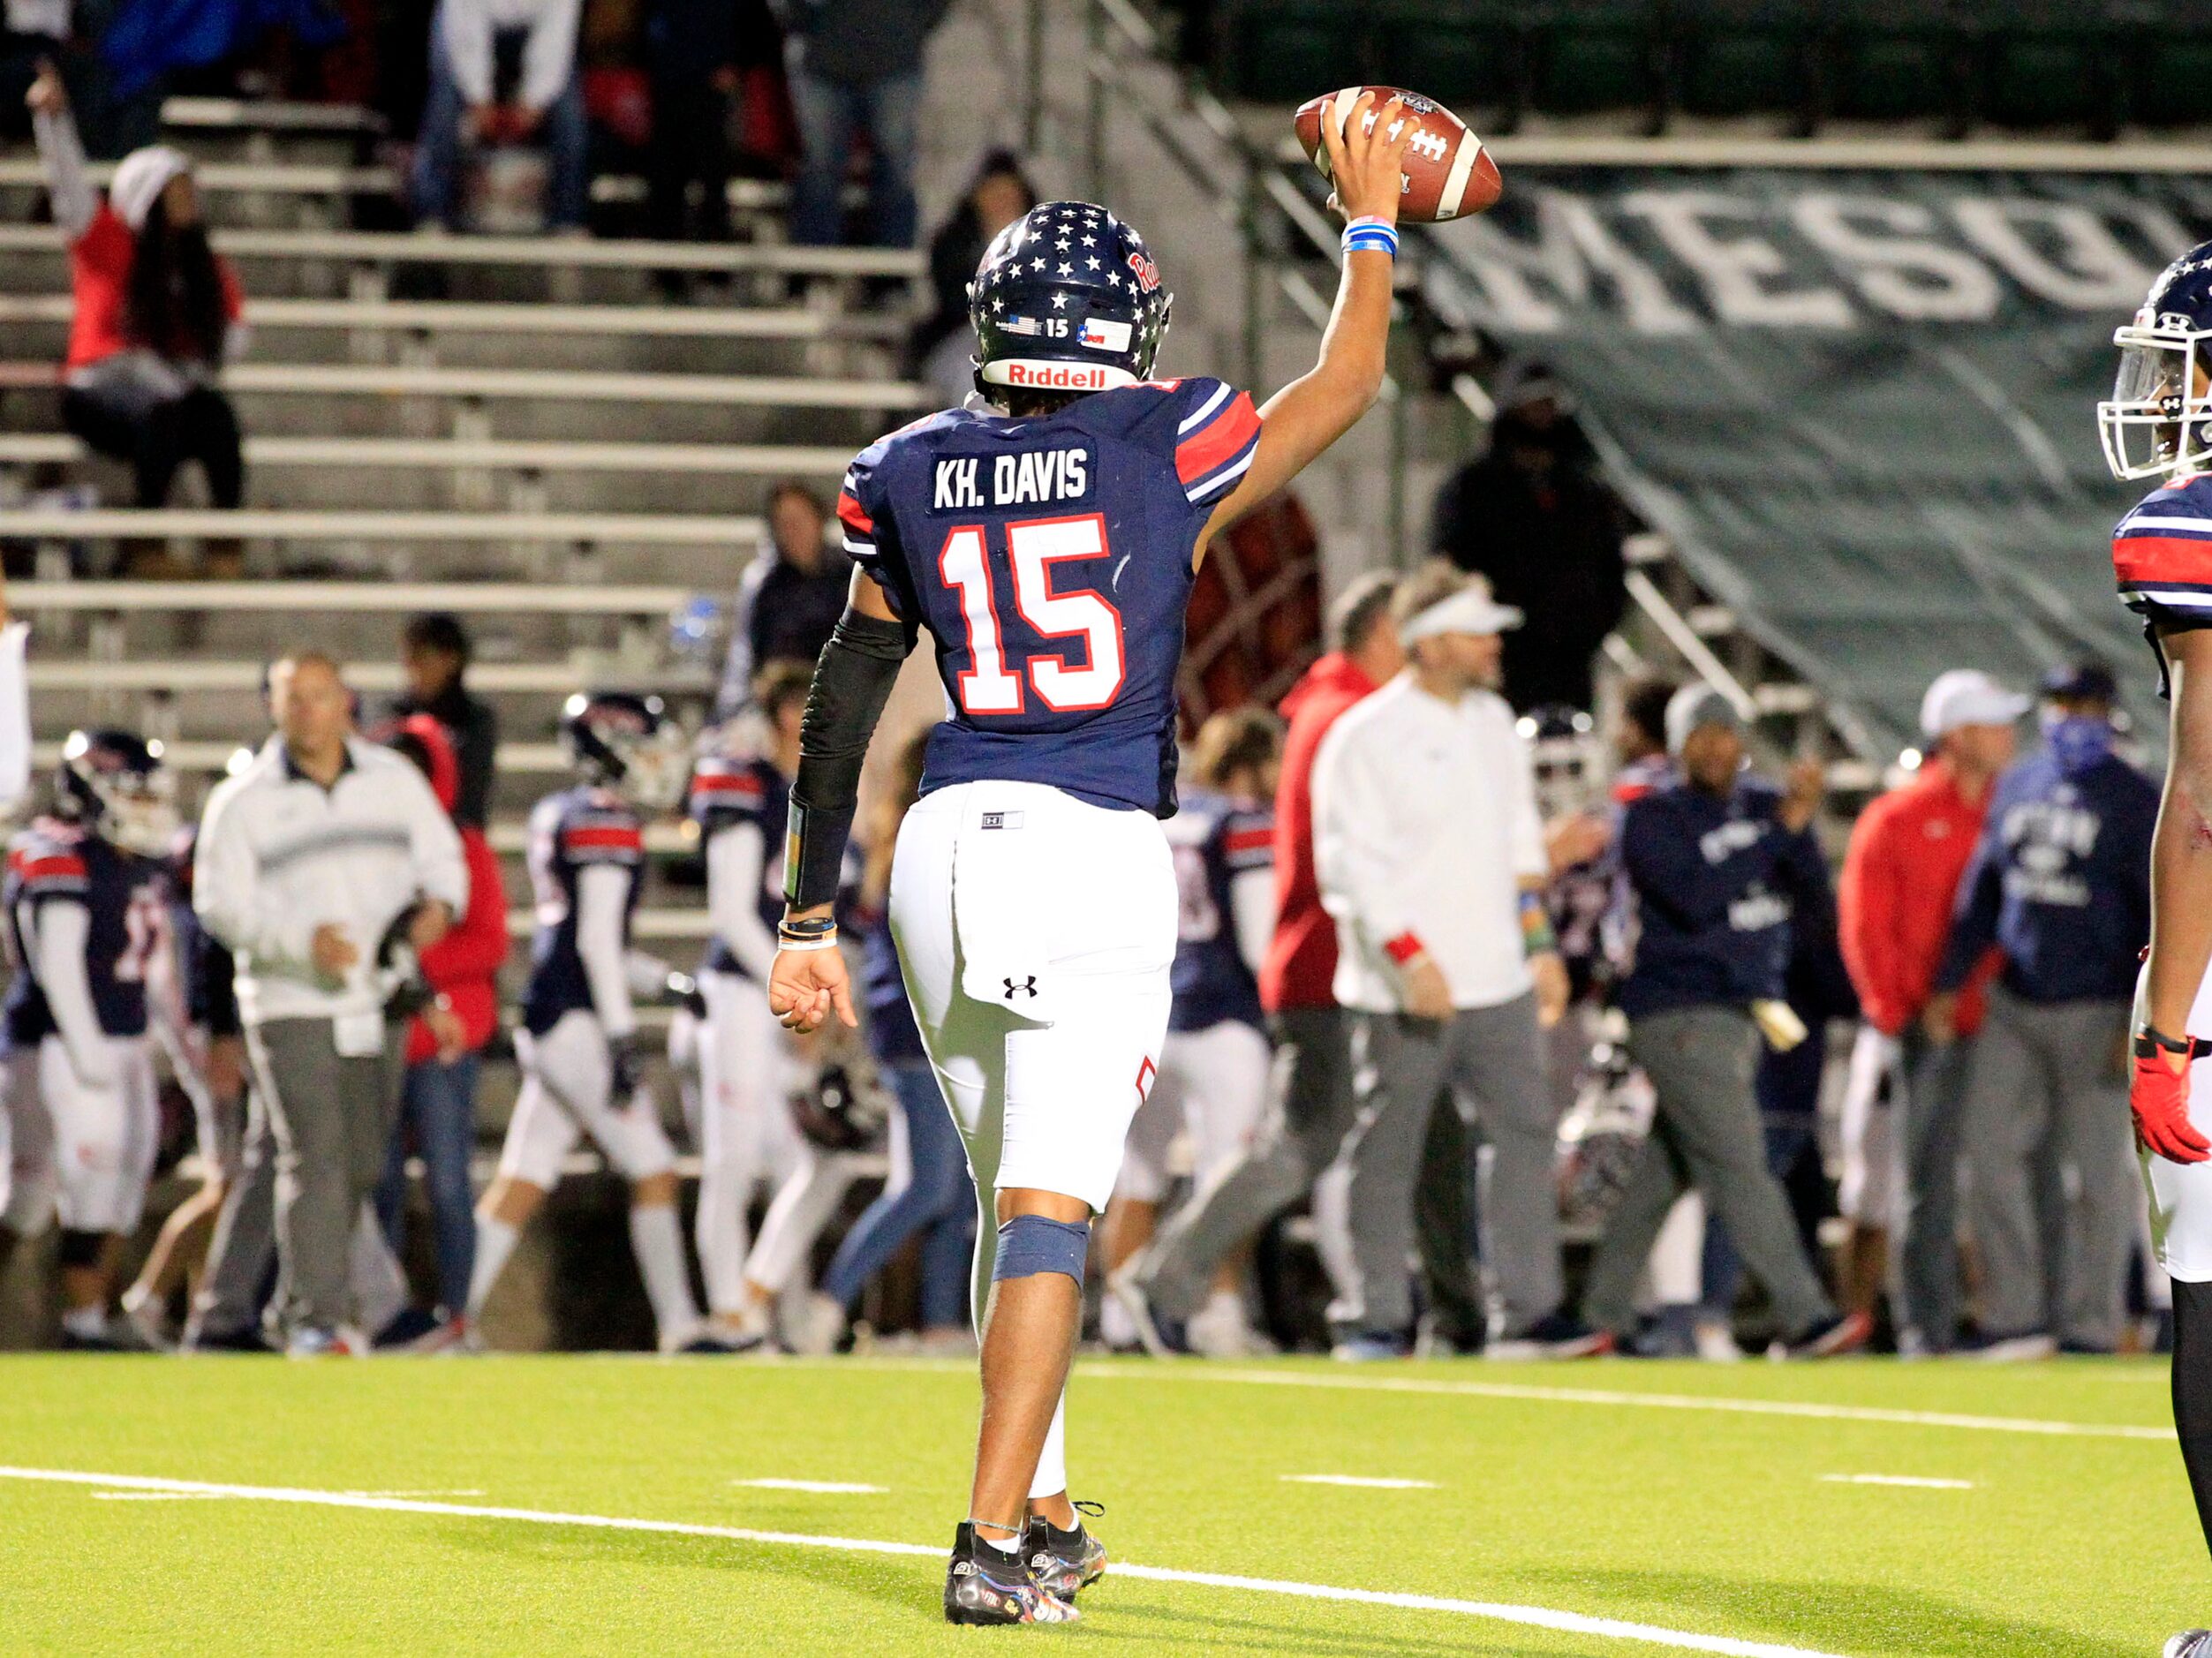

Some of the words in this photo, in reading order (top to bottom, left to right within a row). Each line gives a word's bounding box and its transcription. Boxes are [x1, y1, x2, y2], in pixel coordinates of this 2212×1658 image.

[1046, 318, 1069, 338] 15
[1008, 363, 1106, 389] Riddell
[933, 457, 985, 509] KH.
[993, 448, 1088, 506] DAVIS
[937, 511, 1127, 716] 15
